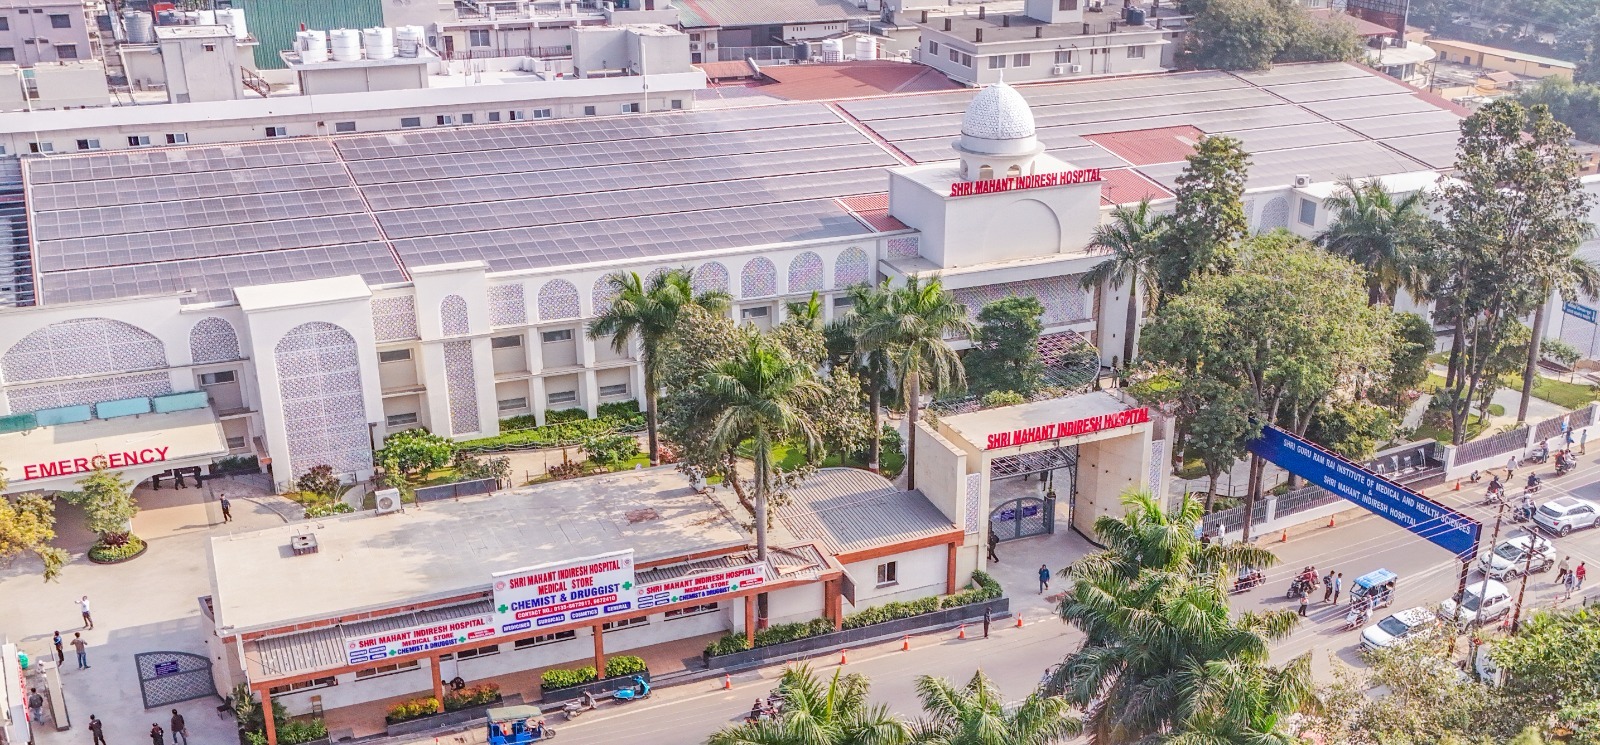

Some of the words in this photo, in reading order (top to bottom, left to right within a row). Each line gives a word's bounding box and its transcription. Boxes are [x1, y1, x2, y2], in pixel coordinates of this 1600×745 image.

[951, 182, 973, 196] SHRI
[975, 178, 1014, 194] MAHANT
[1016, 172, 1058, 189] INDIRESH
[1060, 168, 1101, 185] HOSPITAL
[987, 431, 1011, 449] SHRI
[1013, 424, 1055, 445] MAHANT
[1057, 416, 1102, 437] INDIRESH
[1104, 407, 1150, 428] HOSPITAL
[23, 446, 169, 480] EMERGENCY
[1283, 439, 1296, 451] SHRI
[1297, 445, 1312, 459] GURU
[1312, 452, 1325, 465] RAM
[1325, 459, 1336, 470] RAI
[1336, 464, 1365, 484] INSTITUTE
[1366, 477, 1375, 488] OF
[1375, 482, 1400, 502] MEDICAL
[1401, 495, 1415, 508] AND
[1416, 502, 1440, 519] HEALTH
[1440, 514, 1471, 535] SCIENCES
[1323, 475, 1336, 489] SHRI
[1337, 482, 1361, 500] MAHANT
[1361, 493, 1389, 513] INDIRESH
[1389, 507, 1417, 526] HOSPITAL
[509, 577, 526, 589] SHRI
[527, 571, 557, 586] MAHANT
[558, 565, 588, 579] INDIRESH
[589, 560, 620, 574] HOSPITAL
[646, 585, 662, 595] SHRI
[664, 579, 693, 591] MAHANT
[694, 573, 724, 585] INDIRESH
[726, 568, 755, 579] HOSPITAL
[538, 581, 567, 595] MEDICAL
[571, 576, 593, 589] STORE
[679, 592, 701, 601] CHEMIST
[706, 586, 730, 596] DRUGGIST
[684, 584, 709, 593] MEDICAL
[711, 580, 730, 588] STORE
[511, 595, 556, 611] CHEMIST
[560, 593, 567, 602] &
[570, 583, 620, 599] DRUGGIST
[517, 609, 541, 619] CONTACT
[571, 609, 598, 619] COSMETICS
[607, 604, 628, 613] GENERAL
[503, 622, 531, 632] MEDICINES
[537, 615, 565, 625] SURGICALS
[359, 638, 377, 648] SHRI
[379, 632, 411, 645] MAHANT
[413, 625, 448, 638] INDIRESH
[450, 618, 485, 631] HOSPITAL
[402, 636, 431, 647] MEDICAL
[433, 632, 455, 642] STORE
[397, 644, 424, 655] CHEMIST
[430, 638, 458, 649] DRUGGIST
